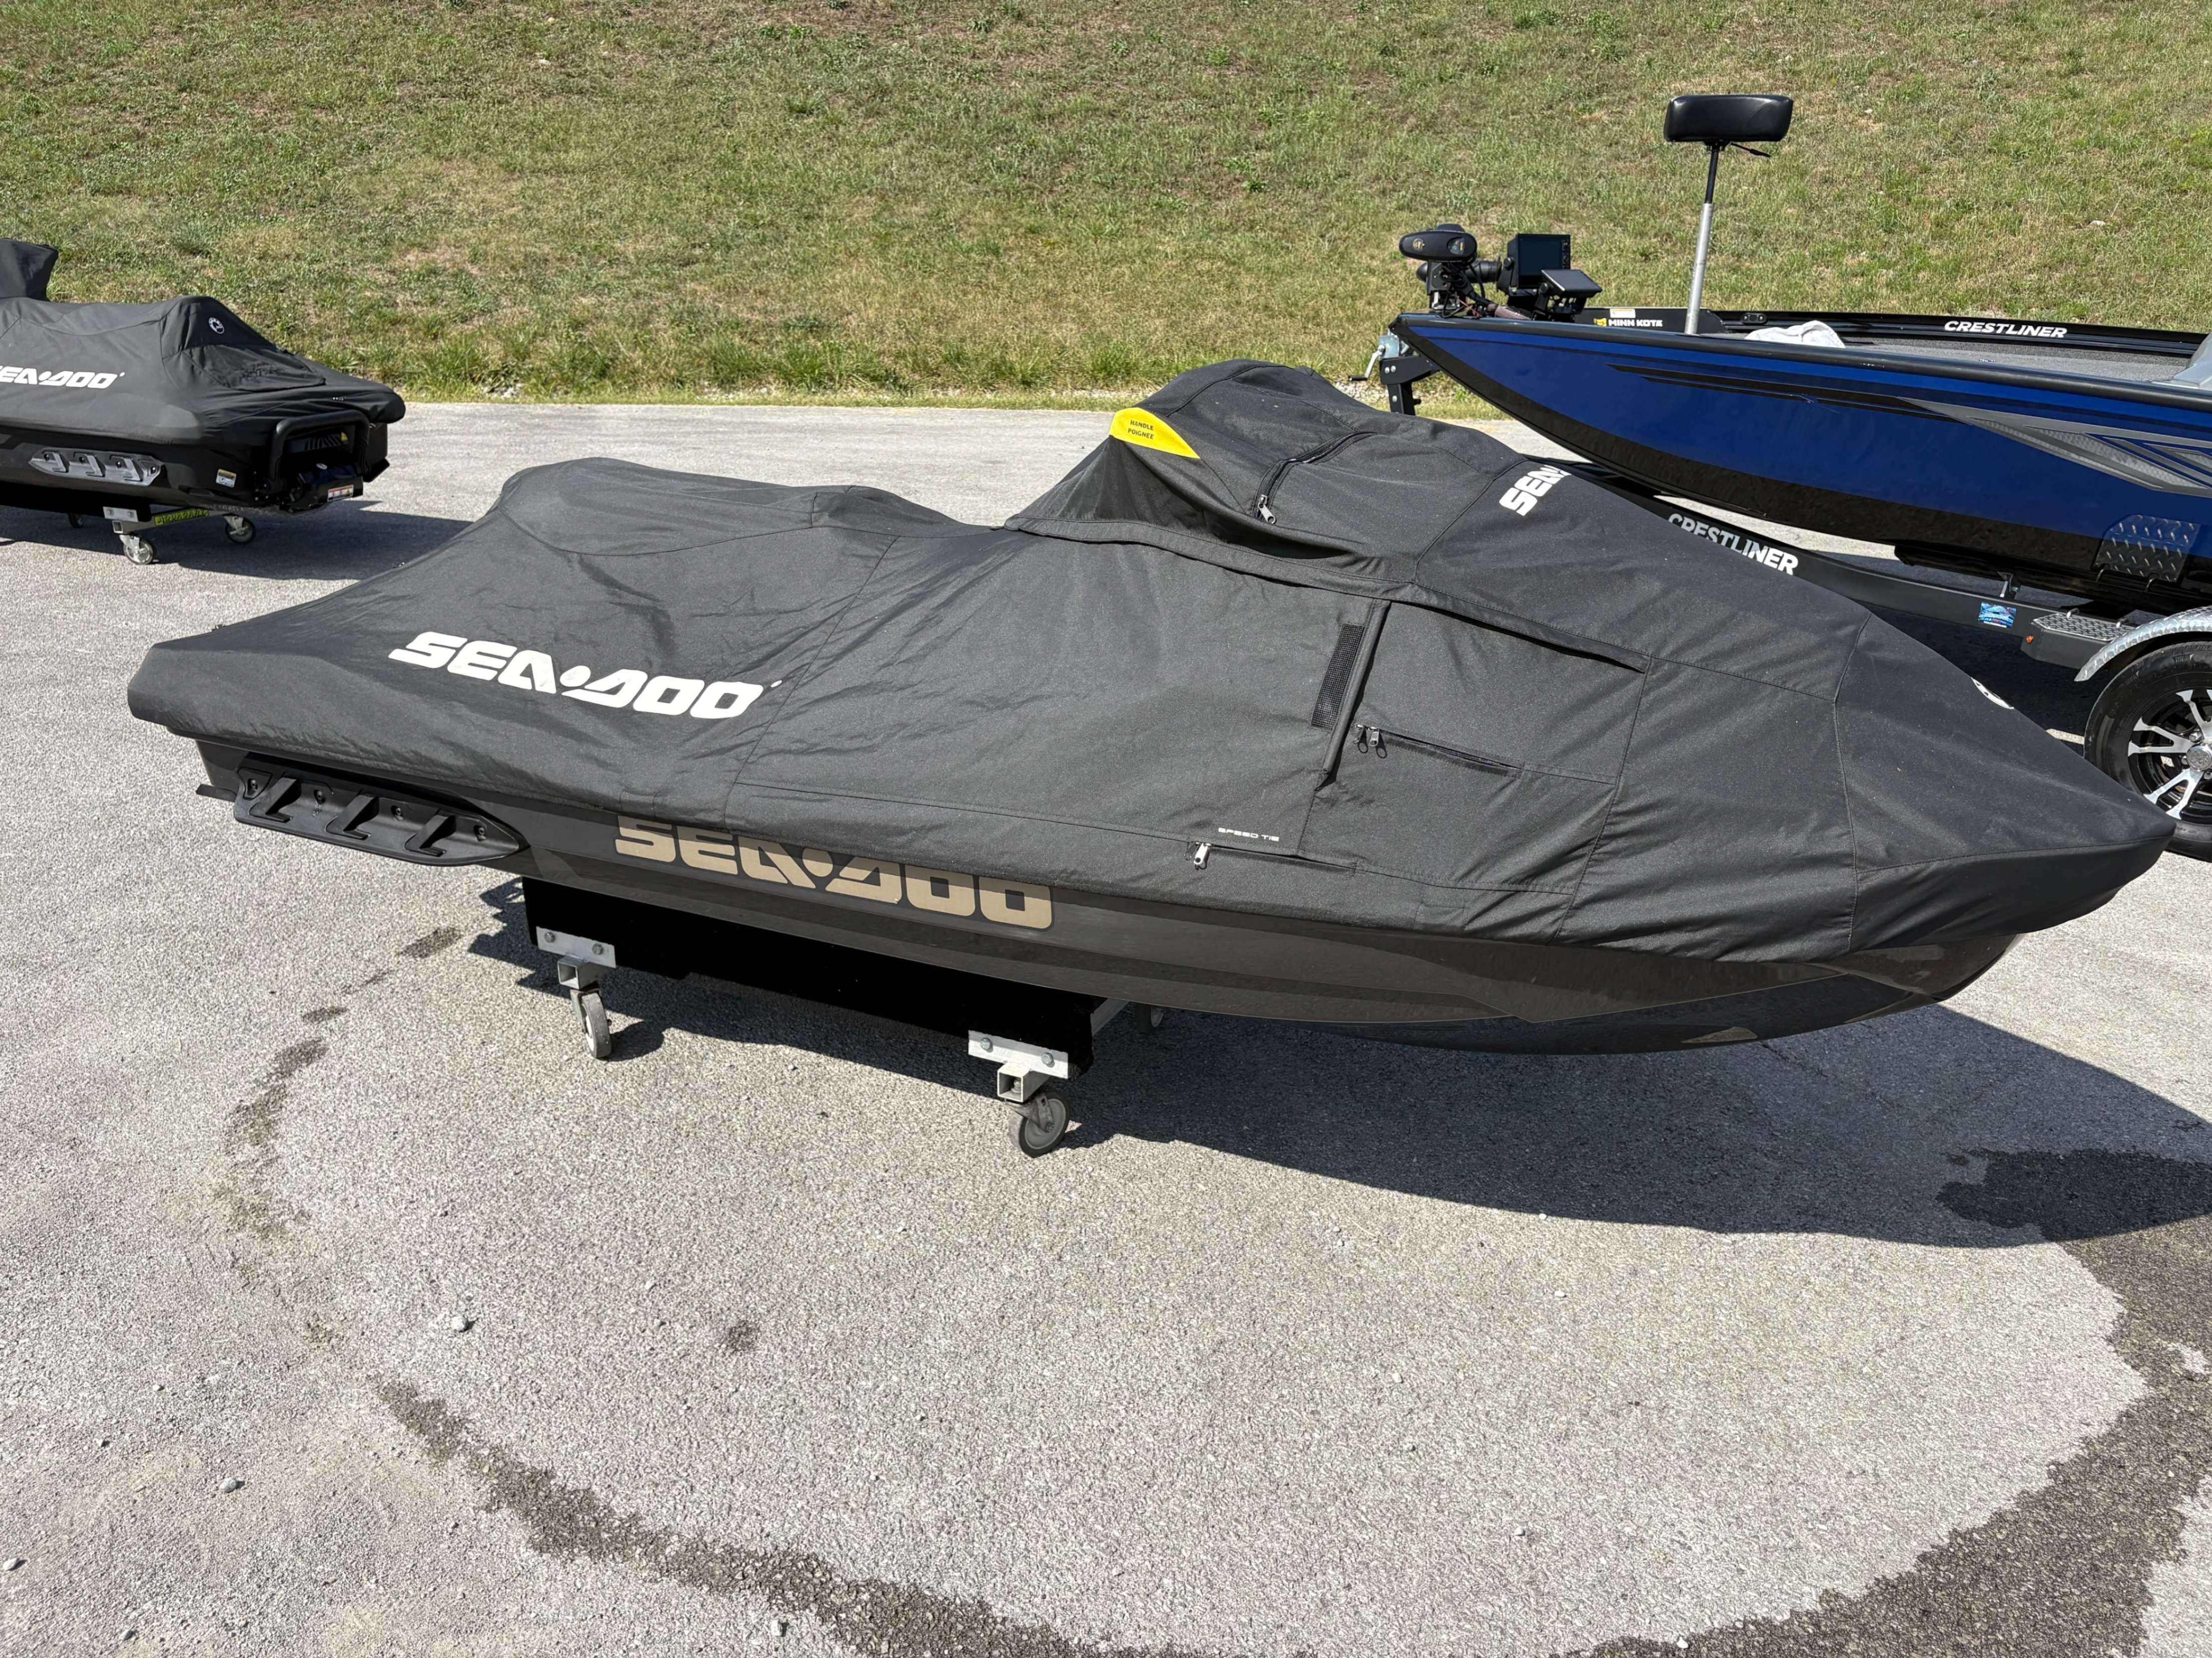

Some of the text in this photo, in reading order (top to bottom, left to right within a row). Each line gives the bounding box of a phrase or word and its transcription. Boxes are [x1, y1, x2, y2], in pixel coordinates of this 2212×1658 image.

[1944, 320, 2067, 338] CRESTLINER
[1130, 419, 1154, 431] HANDLE
[1128, 428, 1155, 440] POIGNEE
[1218, 827, 1259, 839] SPEED
